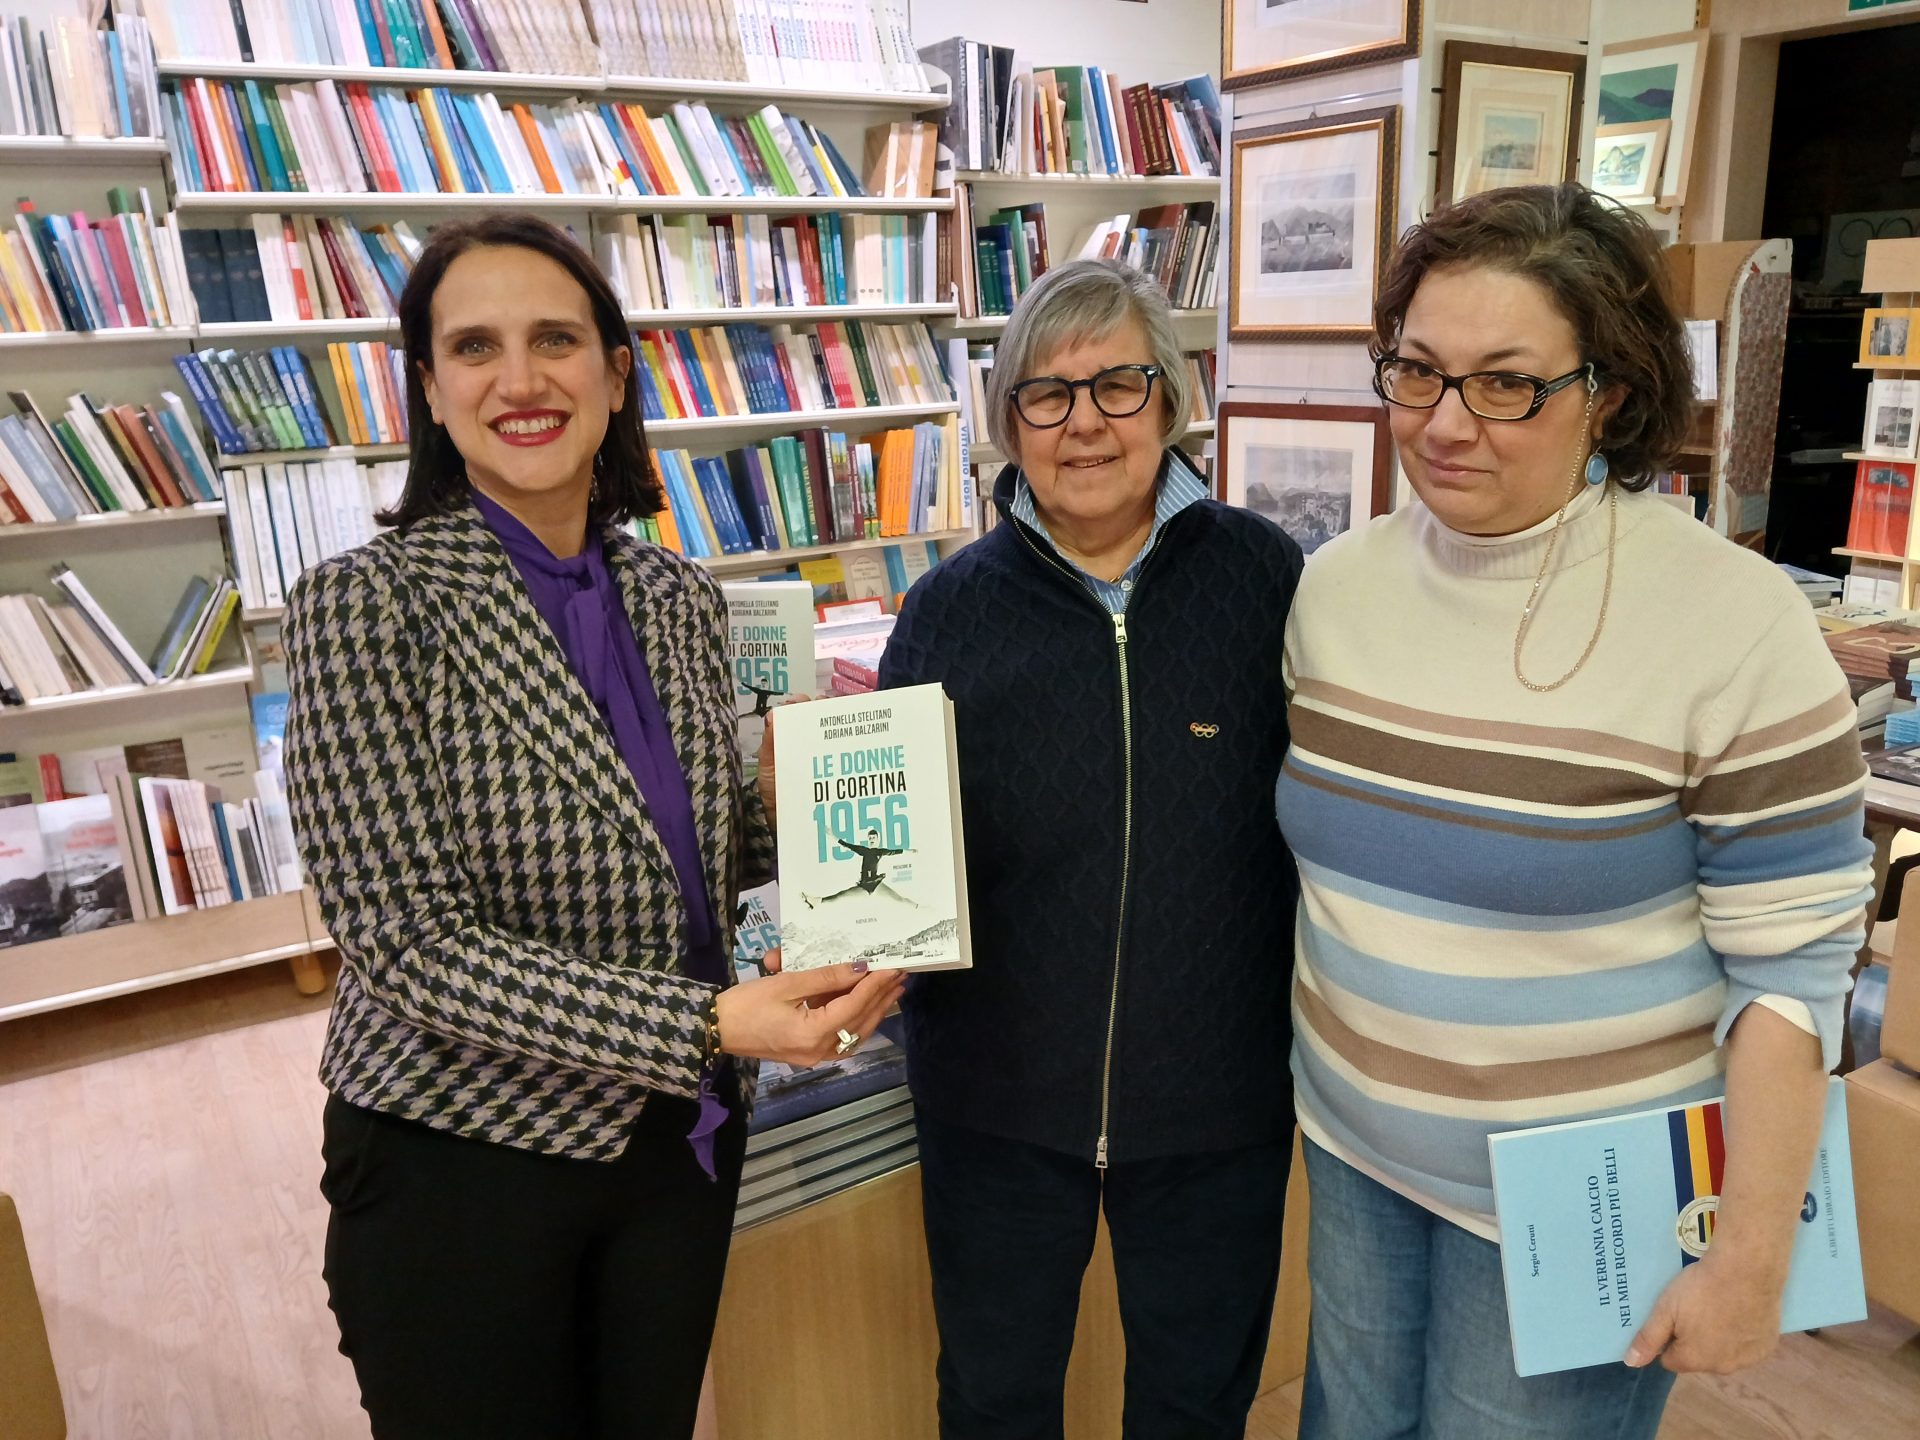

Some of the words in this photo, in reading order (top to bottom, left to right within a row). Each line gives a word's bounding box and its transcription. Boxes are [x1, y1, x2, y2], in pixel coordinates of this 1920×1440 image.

[960, 426, 970, 475] VITTORIO
[963, 480, 971, 508] ROSA
[743, 626, 786, 641] DONNE
[740, 643, 788, 657] CORTINA
[729, 658, 788, 695] 956
[820, 713, 856, 727] ANTONELLA
[858, 708, 892, 722] STELITANO
[824, 727, 853, 740] ADRIANA
[855, 722, 889, 736] BALZARINI
[812, 754, 834, 779] LE
[840, 745, 905, 775] DONNE
[814, 781, 829, 802] DI
[836, 771, 906, 800] CORTINA
[813, 794, 910, 863] 1956
[1604, 1147, 1618, 1185] BELLI
[1820, 1148, 1831, 1184] EDITORE
[1587, 1175, 1602, 1225] CALCIO
[1606, 1188, 1621, 1211] PIÙ
[1824, 1186, 1834, 1221] LIBRAIO
[1526, 1224, 1537, 1252] Cerutti
[1611, 1213, 1626, 1272] RICORDI
[1827, 1223, 1838, 1258] ALBERTI
[1531, 1253, 1540, 1277] Sergio
[1593, 1227, 1609, 1292] VERBANIA
[1600, 1292, 1610, 1306] IL
[1615, 1273, 1629, 1303] MIEI
[1620, 1304, 1632, 1328] NEI
